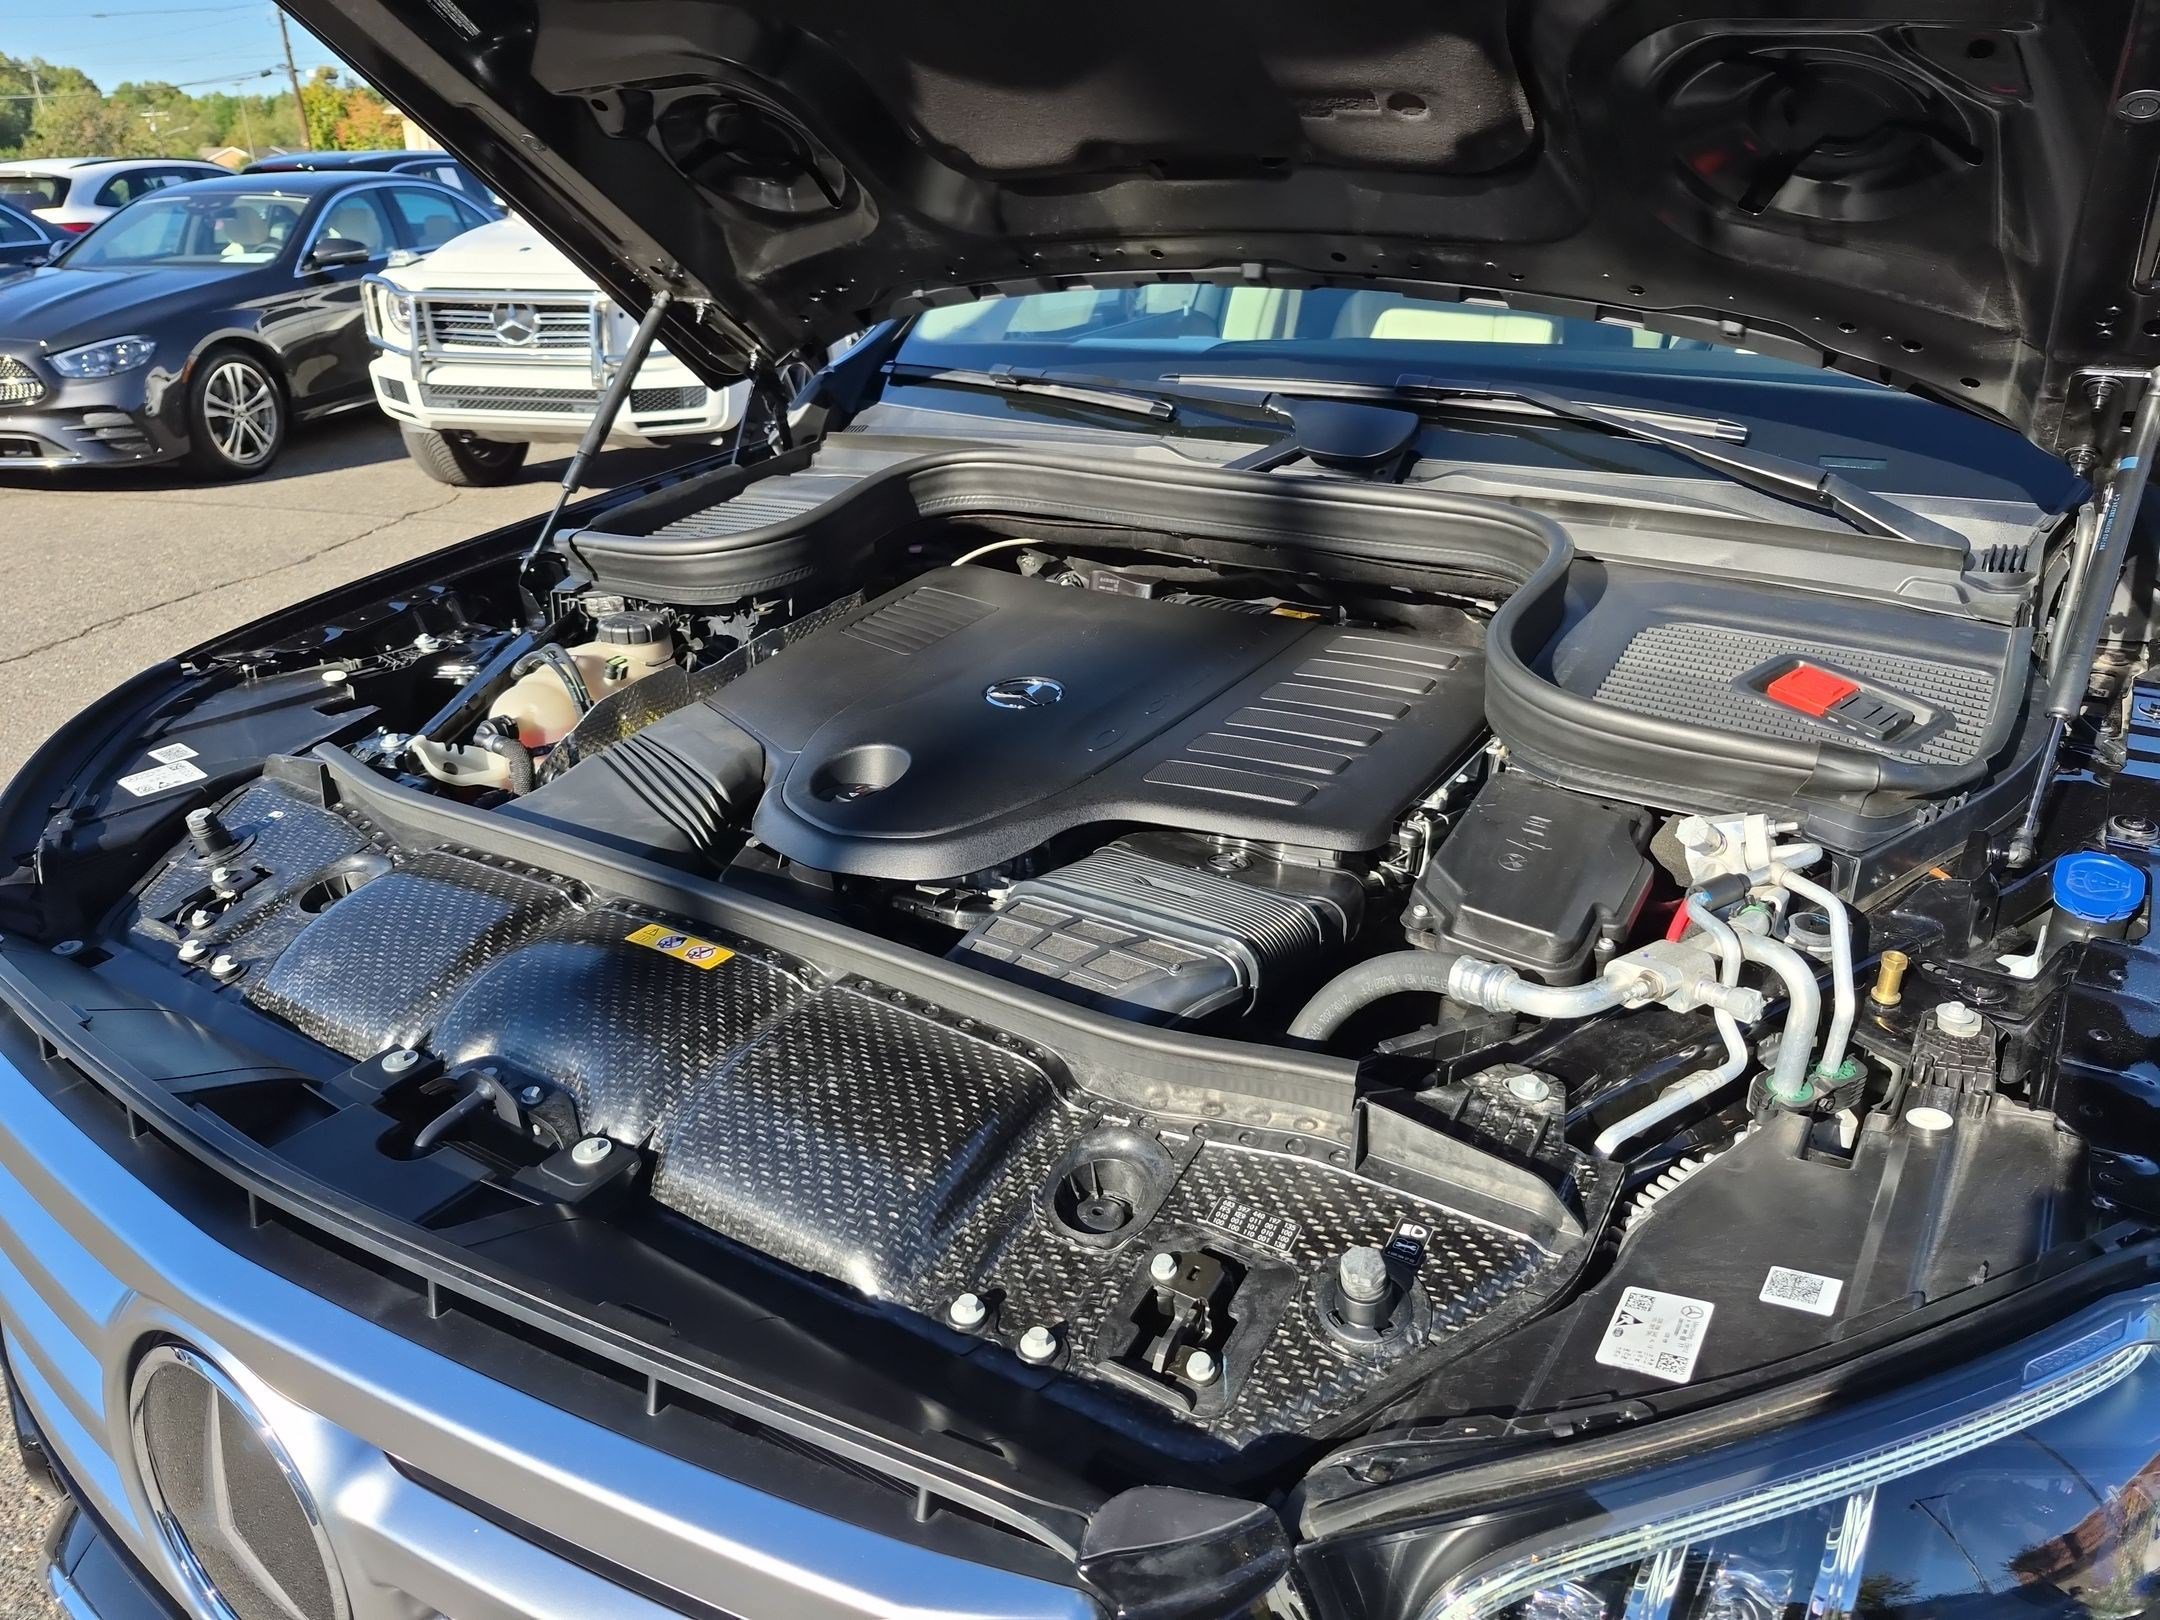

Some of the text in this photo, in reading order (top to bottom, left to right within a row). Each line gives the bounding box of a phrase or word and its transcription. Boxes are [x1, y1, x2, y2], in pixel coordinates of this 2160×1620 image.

[1213, 1217, 1225, 1225] 100
[1228, 1223, 1240, 1231] 100
[1243, 1229, 1255, 1237] 110
[1257, 1234, 1270, 1242] 001
[1215, 1211, 1289, 1242] 010 001 101 010 100
[1249, 1216, 1262, 1225] 011
[1264, 1222, 1278, 1230] 001
[1281, 1228, 1292, 1236] 100
